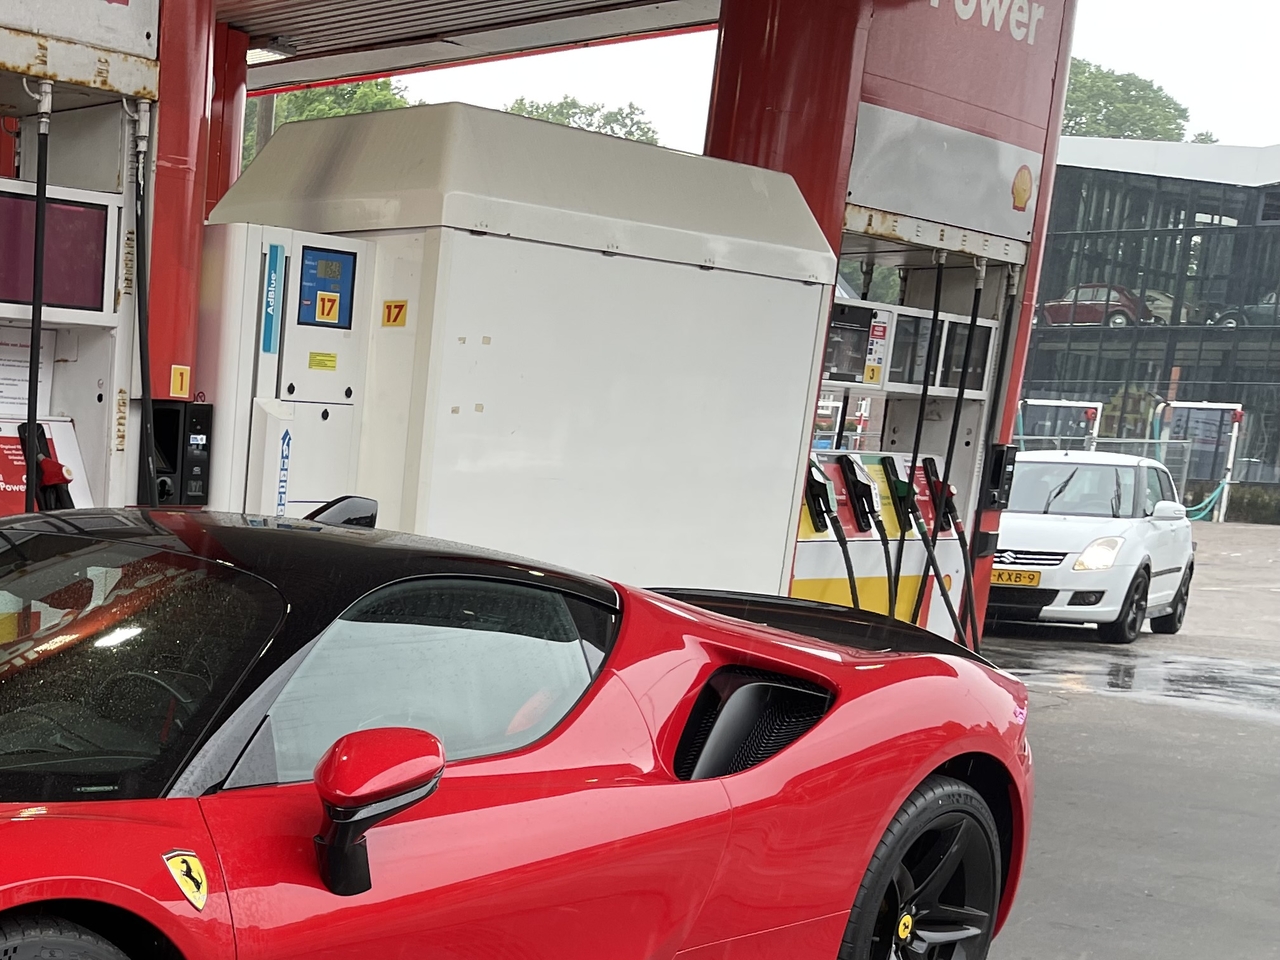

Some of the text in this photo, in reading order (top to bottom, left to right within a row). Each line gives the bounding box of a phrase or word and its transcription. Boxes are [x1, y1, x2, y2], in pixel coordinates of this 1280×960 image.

[930, 0, 1045, 45] ower
[320, 298, 336, 316] 17
[386, 305, 405, 322] 17
[179, 372, 184, 391] 1
[870, 368, 875, 380] 3
